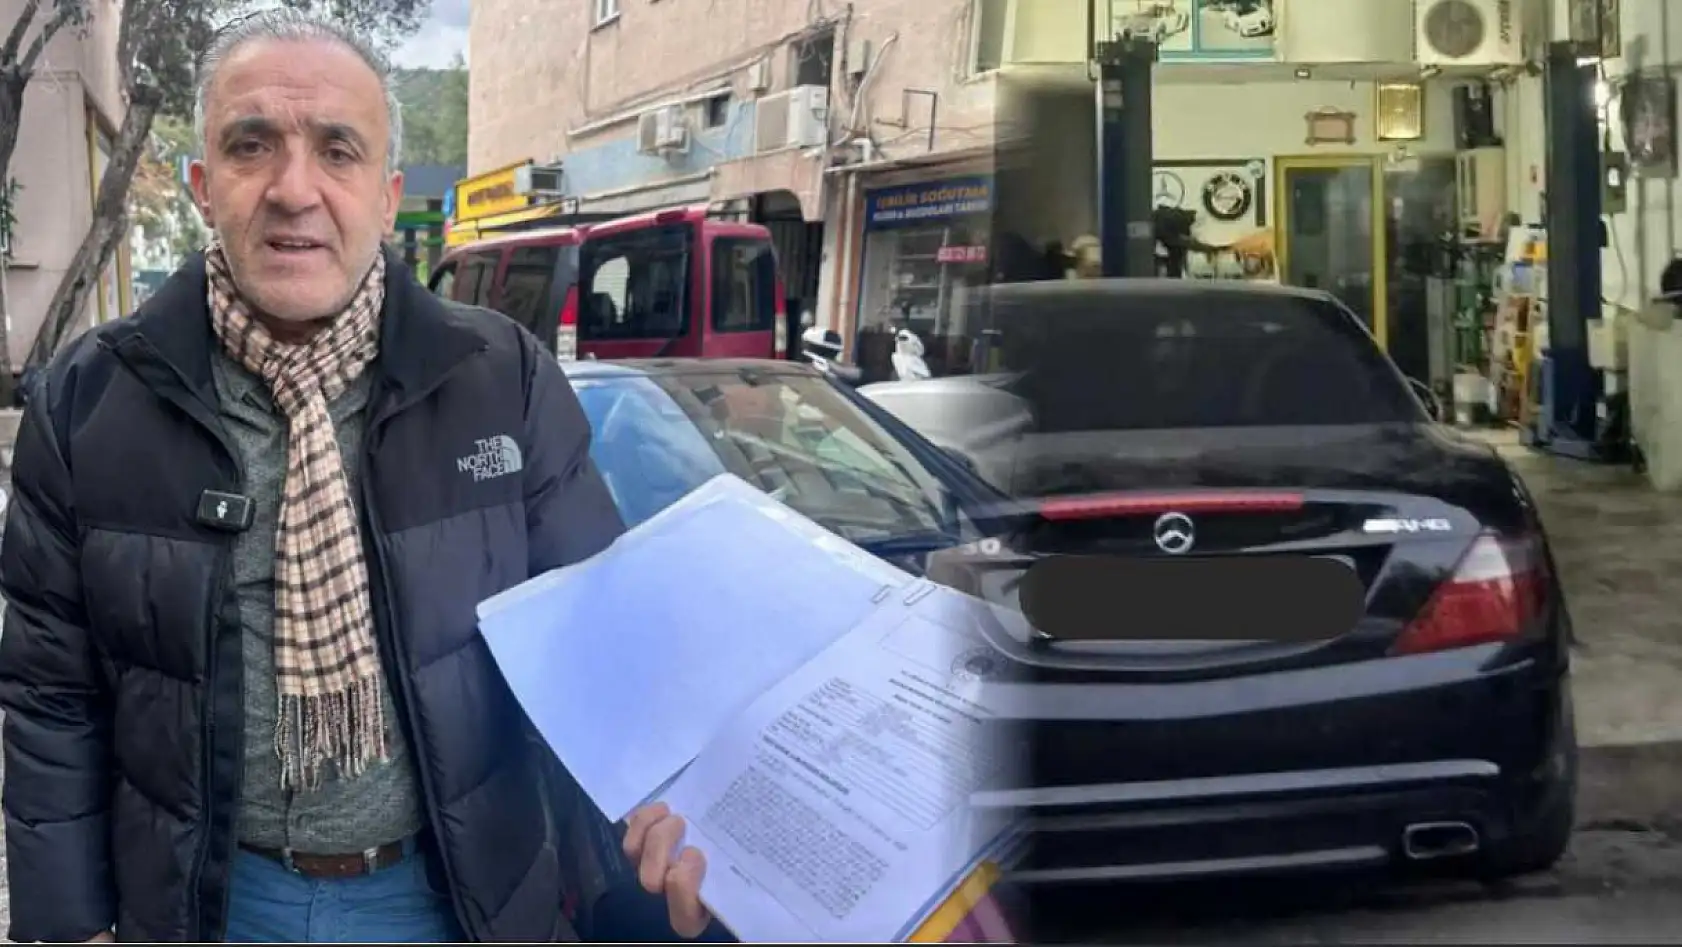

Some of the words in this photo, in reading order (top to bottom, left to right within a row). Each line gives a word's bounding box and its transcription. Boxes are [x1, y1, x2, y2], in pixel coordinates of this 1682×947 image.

[474, 435, 502, 453] THE
[457, 449, 504, 472] NORTH
[473, 463, 503, 482] FACE
